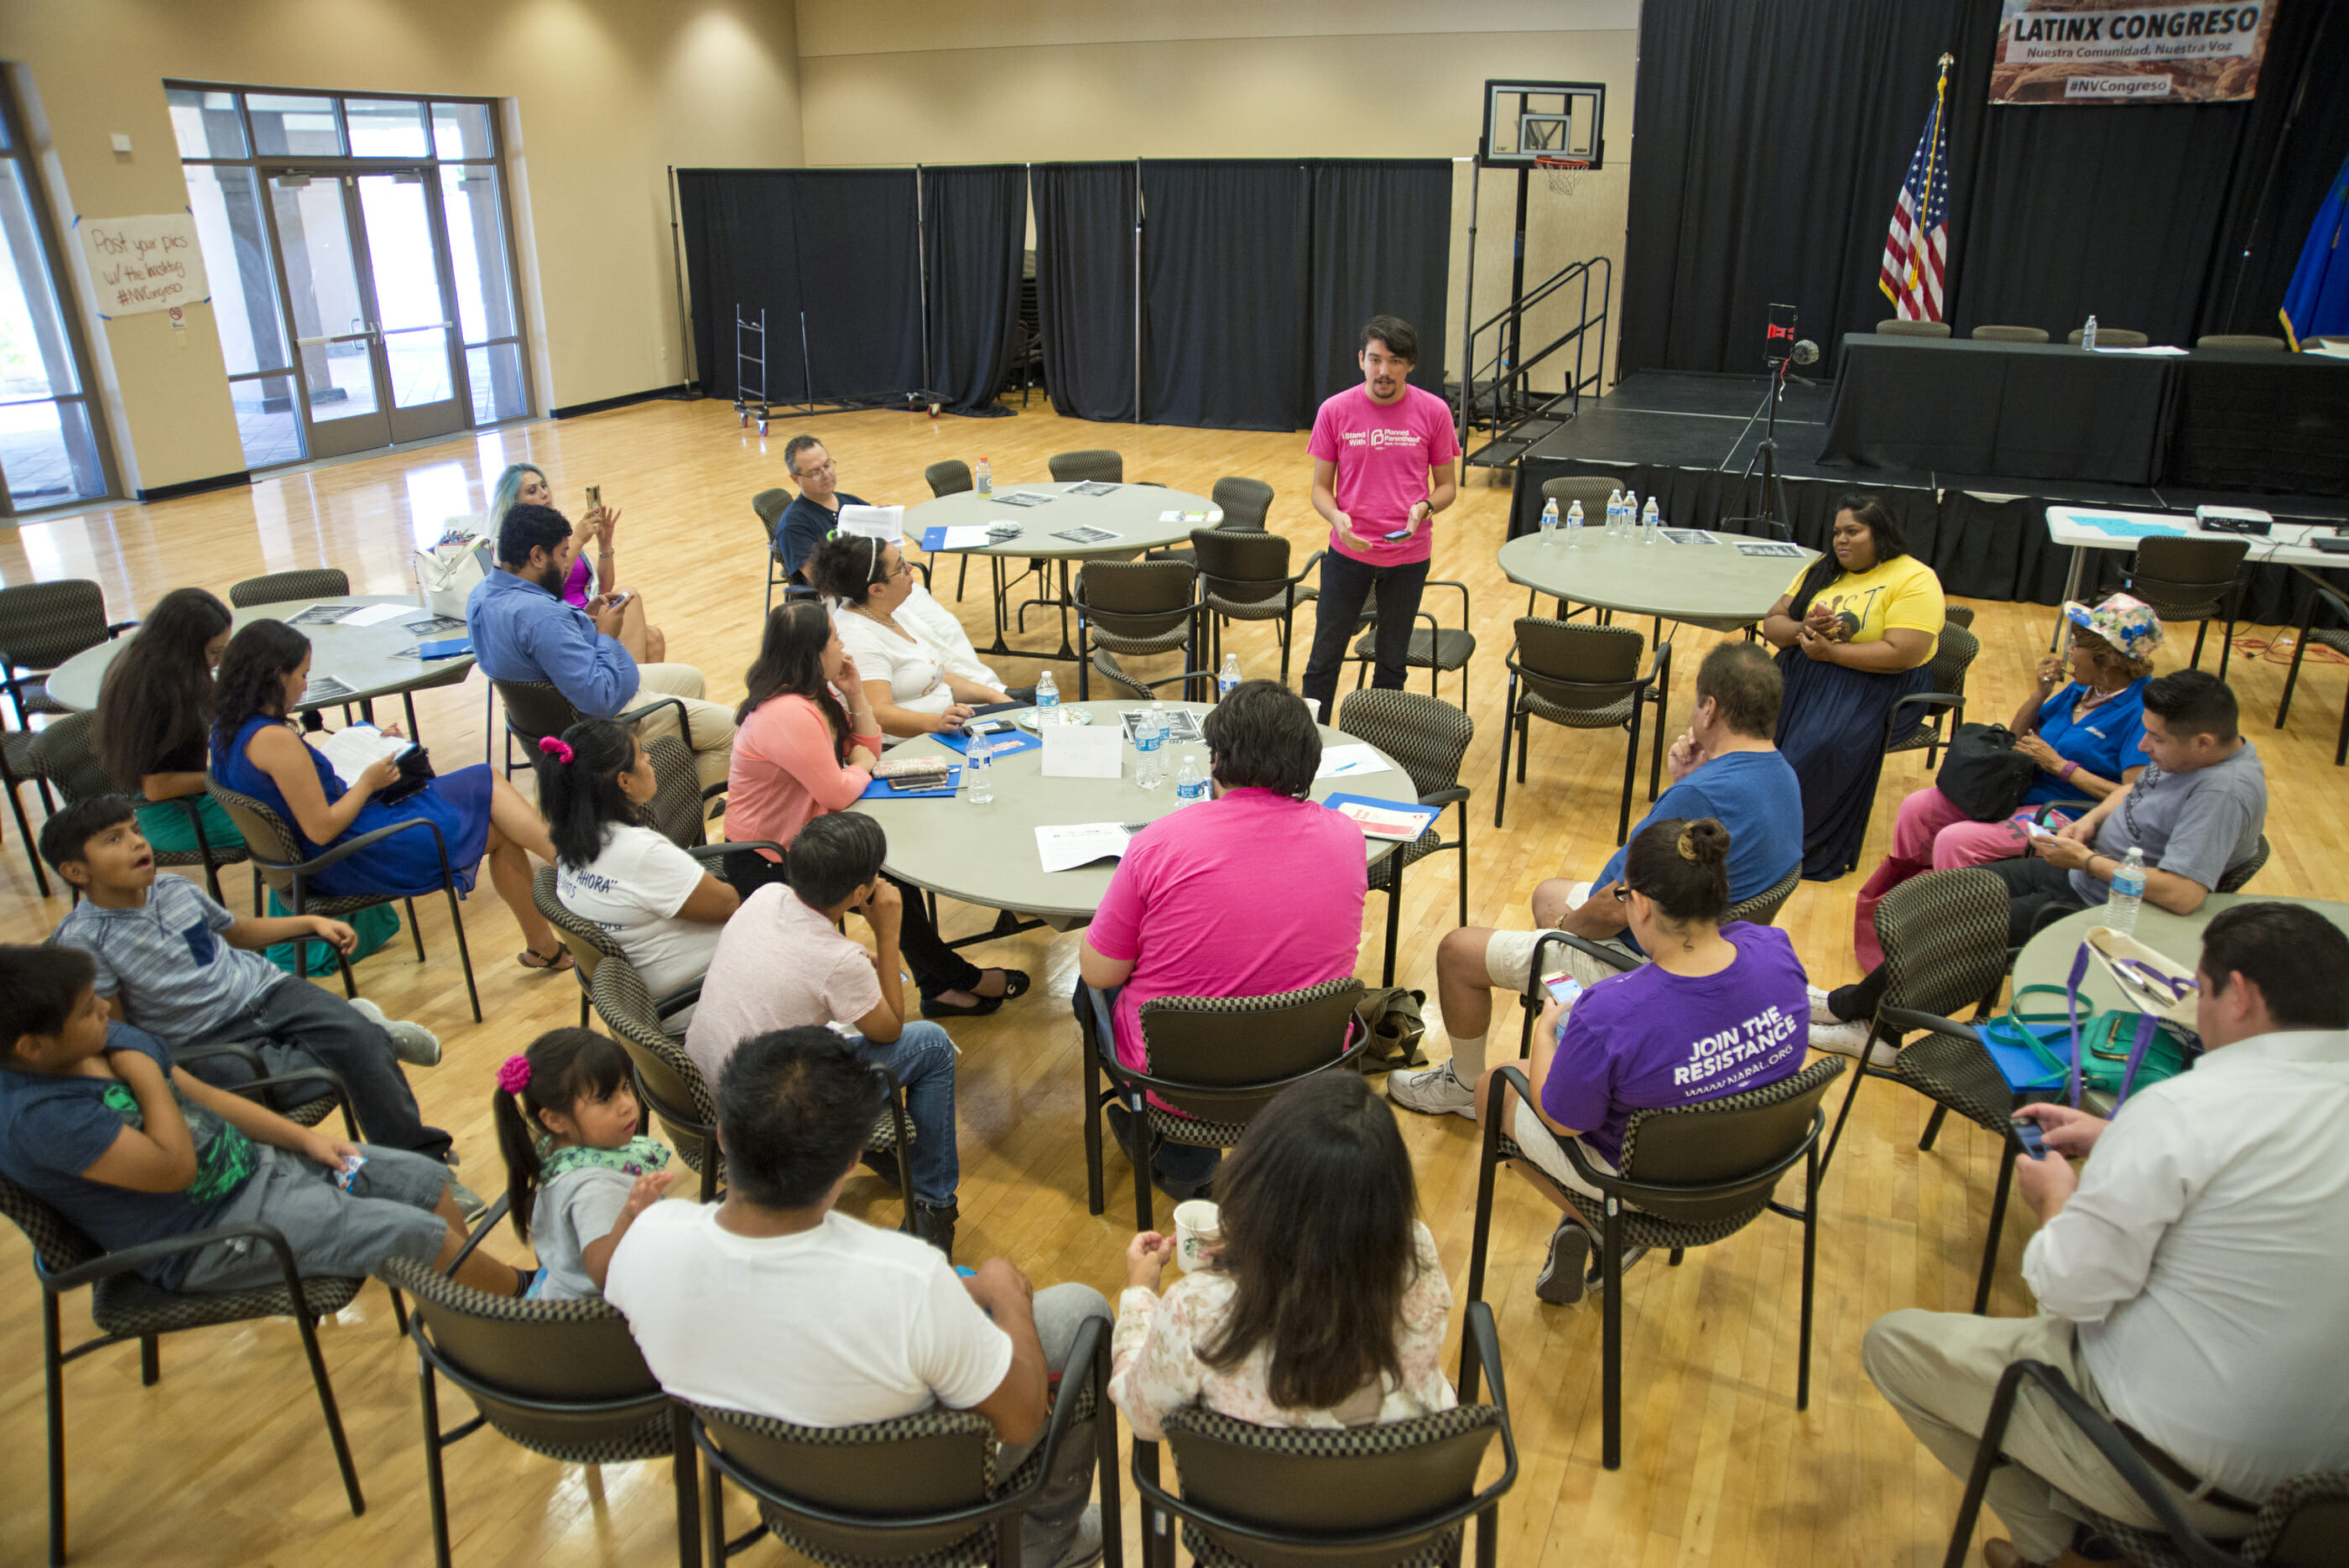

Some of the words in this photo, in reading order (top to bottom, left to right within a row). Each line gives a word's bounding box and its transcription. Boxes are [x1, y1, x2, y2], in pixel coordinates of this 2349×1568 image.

[2014, 17, 2103, 42] LATINX
[2109, 7, 2258, 39] CONGRESO
[2027, 45, 2073, 59] Nuestra
[2076, 44, 2153, 58] Comunidad,
[2155, 42, 2205, 55] Nuestra
[2208, 41, 2232, 53] Voz
[2070, 79, 2167, 96] #NVCongreso
[91, 228, 127, 255] Post
[133, 238, 158, 261] your
[162, 235, 188, 253] pics
[124, 266, 146, 283] the
[144, 261, 185, 279] hashtag
[117, 283, 183, 307] #NVCongreso
[1345, 430, 1366, 439] Stand
[1349, 438, 1366, 446] With
[1689, 1028, 1740, 1062] JOIN
[1742, 1005, 1783, 1037] THE
[1674, 1013, 1797, 1086] RESISTANCE
